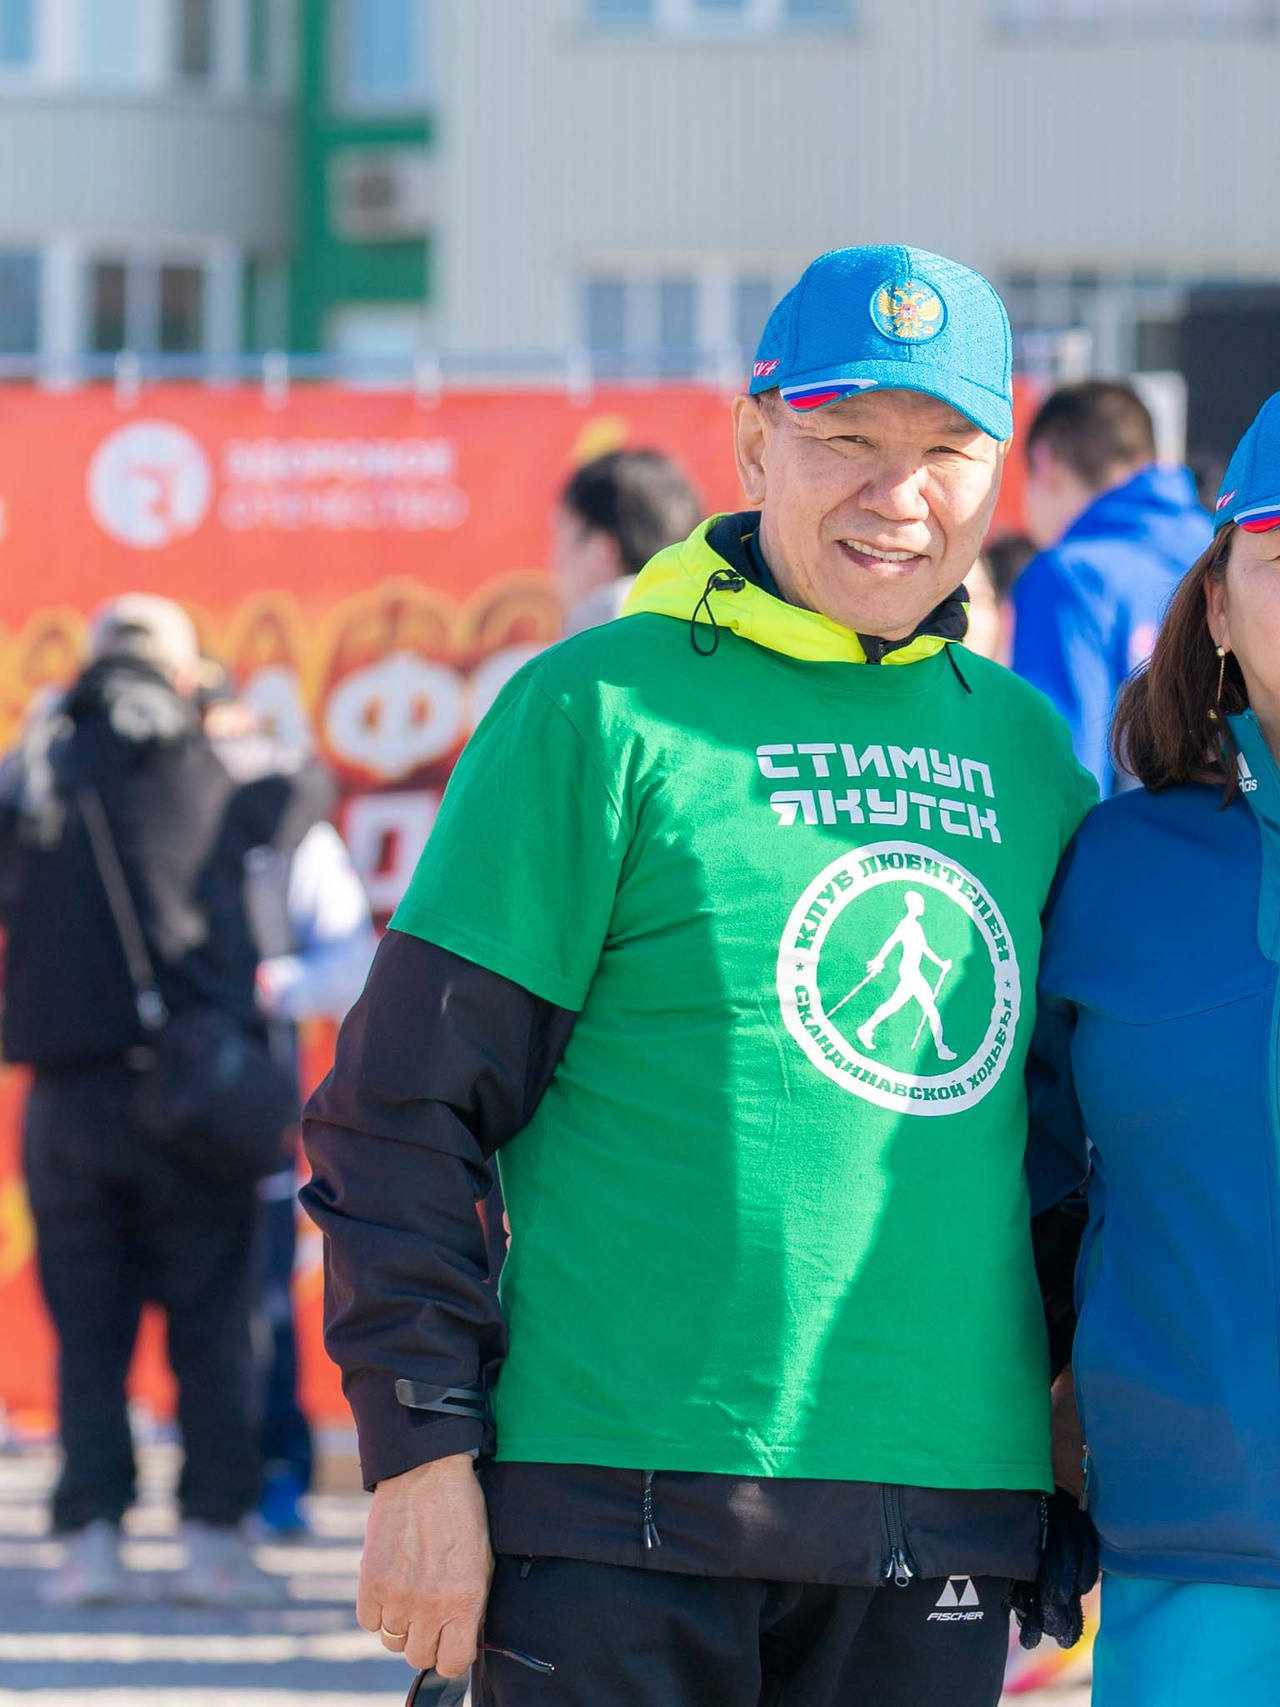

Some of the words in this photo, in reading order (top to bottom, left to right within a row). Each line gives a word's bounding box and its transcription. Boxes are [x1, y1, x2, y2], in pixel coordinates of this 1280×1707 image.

[756, 743, 995, 798] СТИМУЛ
[1238, 778, 1258, 793] das
[769, 788, 1002, 844] ЯКУТСК
[794, 869, 854, 951] КЛУБ
[794, 985, 967, 1102] СКАНДИНАВСКОЙ
[967, 998, 1013, 1092] ХОДЬБЫ
[926, 1611, 984, 1621] FISCHER
